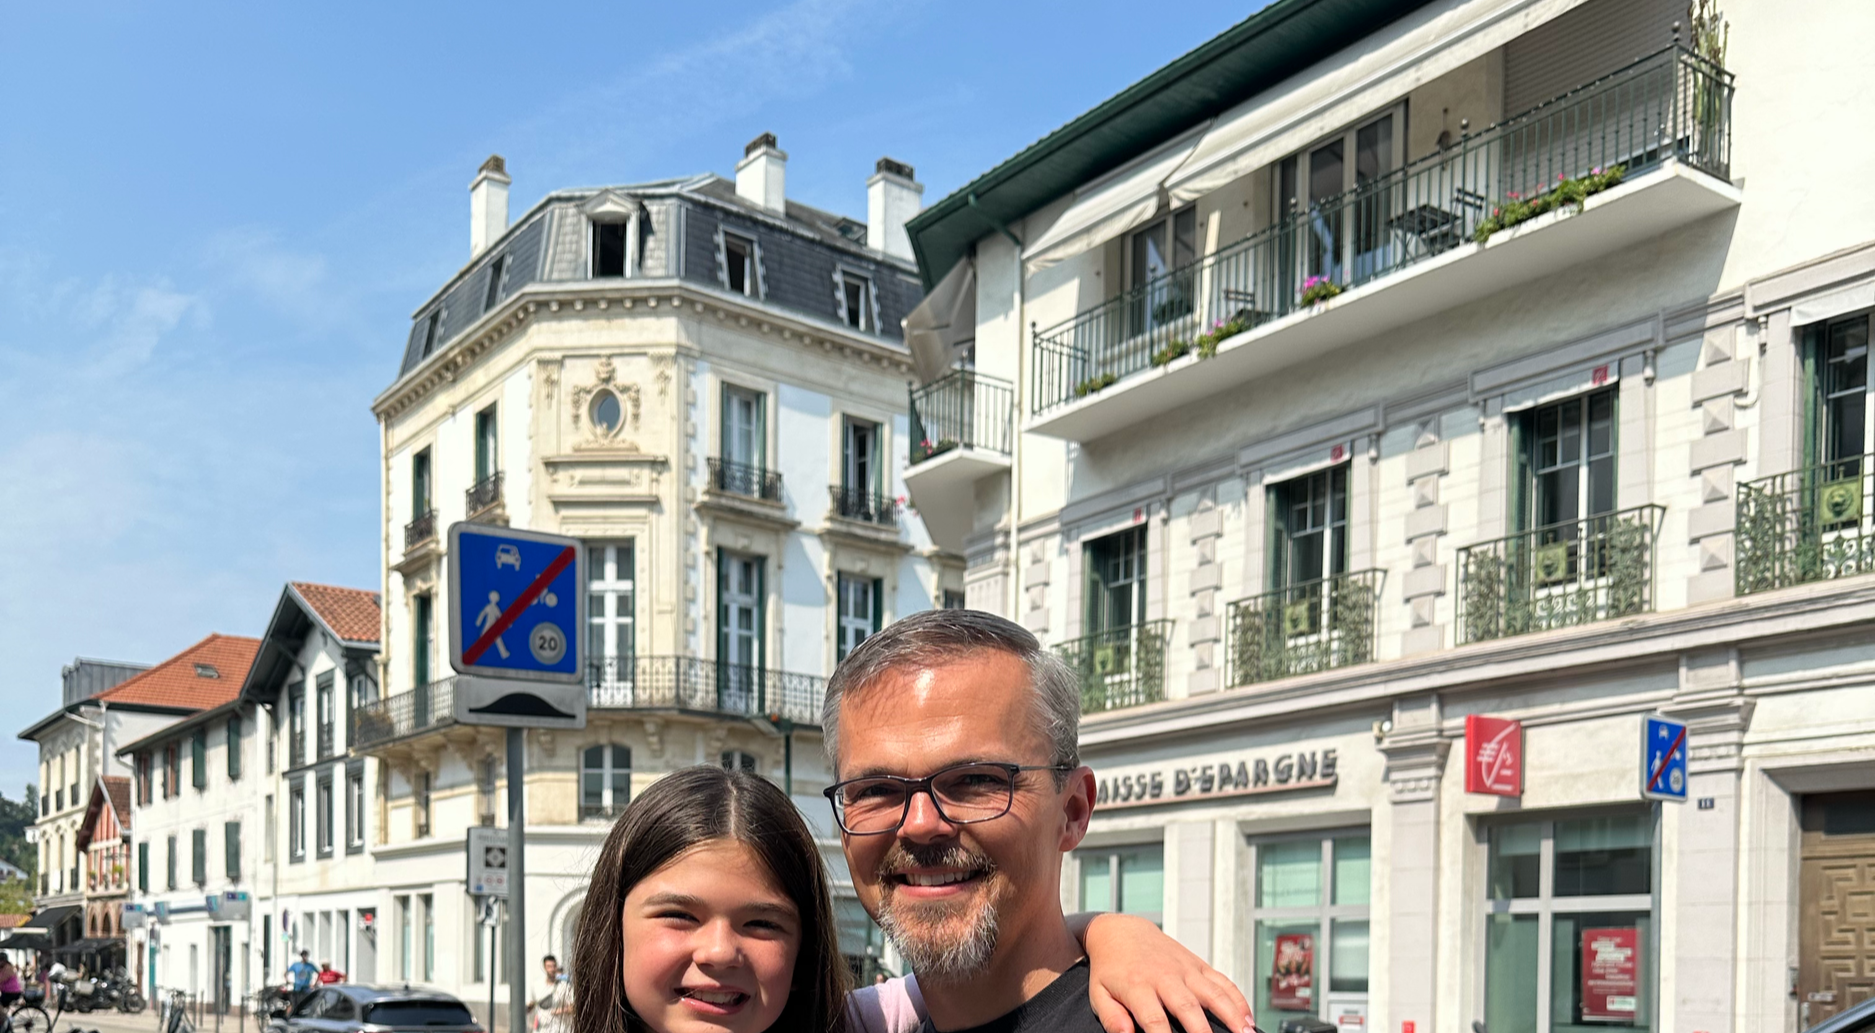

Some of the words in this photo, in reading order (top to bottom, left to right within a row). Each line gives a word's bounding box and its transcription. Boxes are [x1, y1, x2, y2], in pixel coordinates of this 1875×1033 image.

[538, 636, 558, 652] 20
[1097, 772, 1163, 803] AISSE
[1174, 749, 1338, 796] D'EPARGNE
